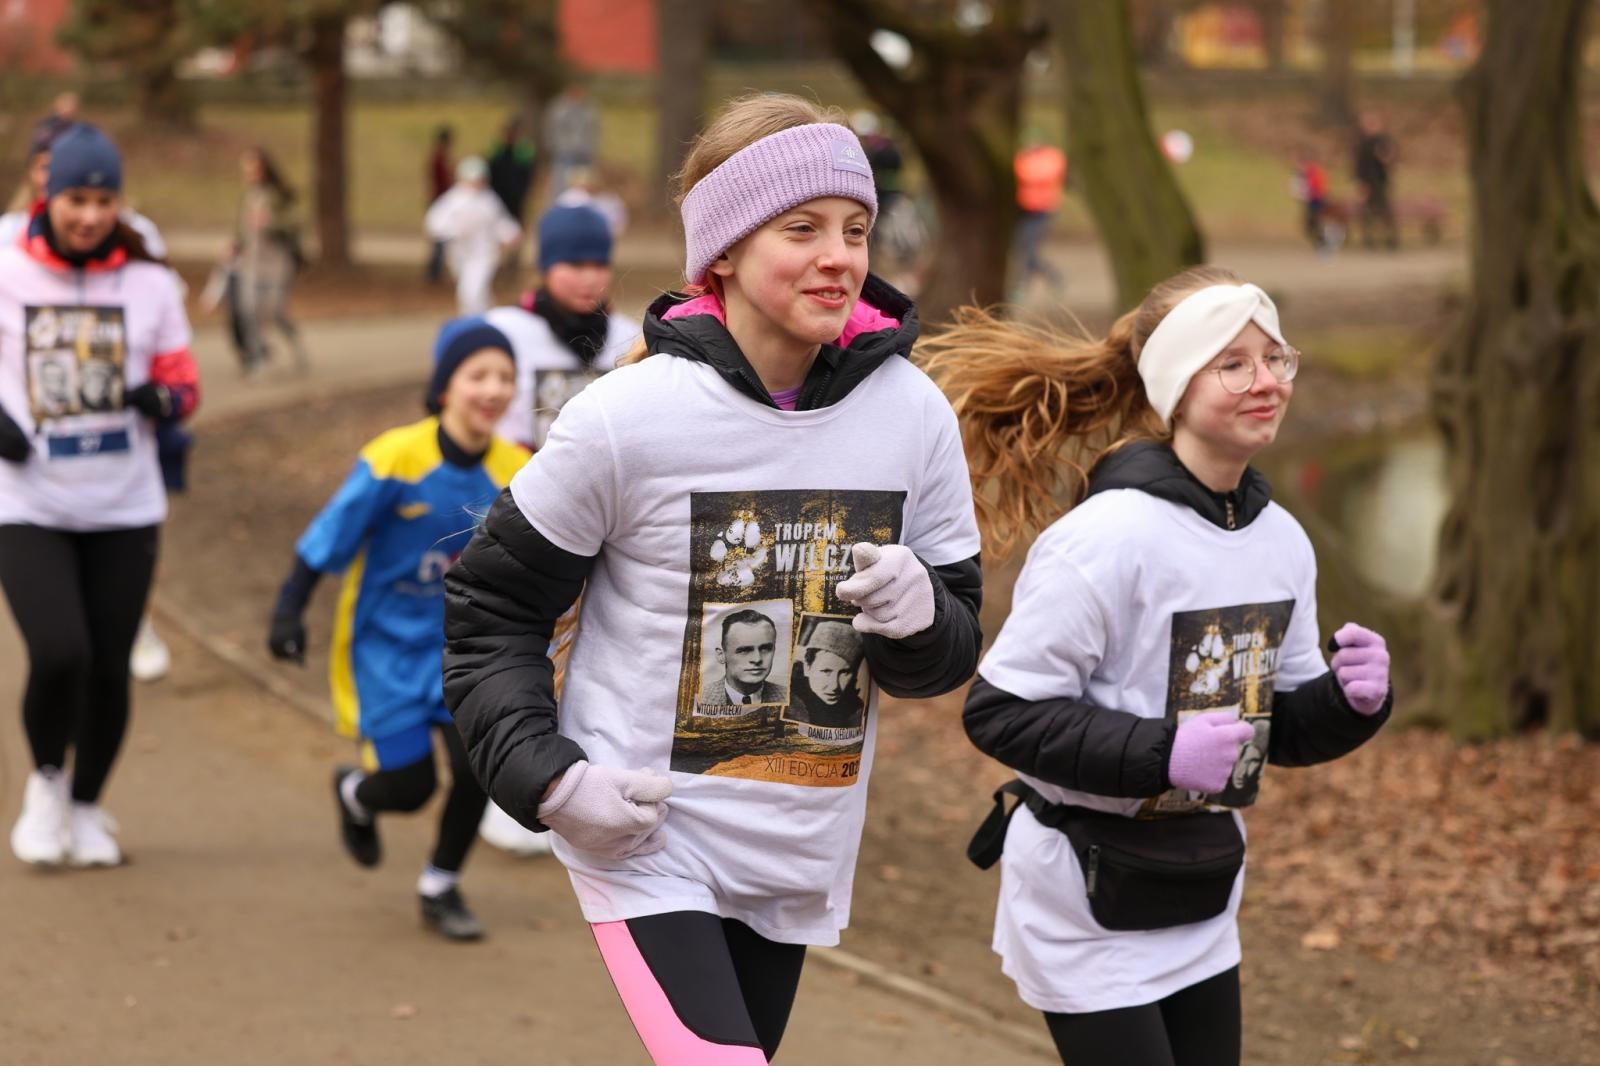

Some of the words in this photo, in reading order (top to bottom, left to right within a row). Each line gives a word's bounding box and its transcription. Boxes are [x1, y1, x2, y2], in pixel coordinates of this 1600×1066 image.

[774, 523, 837, 541] TROPEM
[774, 543, 853, 573] WILCZ
[696, 703, 718, 716] WITOLD
[719, 704, 743, 716] PILECKI
[808, 727, 833, 741] DANUTA
[764, 756, 785, 773] XIII
[789, 760, 839, 778] EDYCJA
